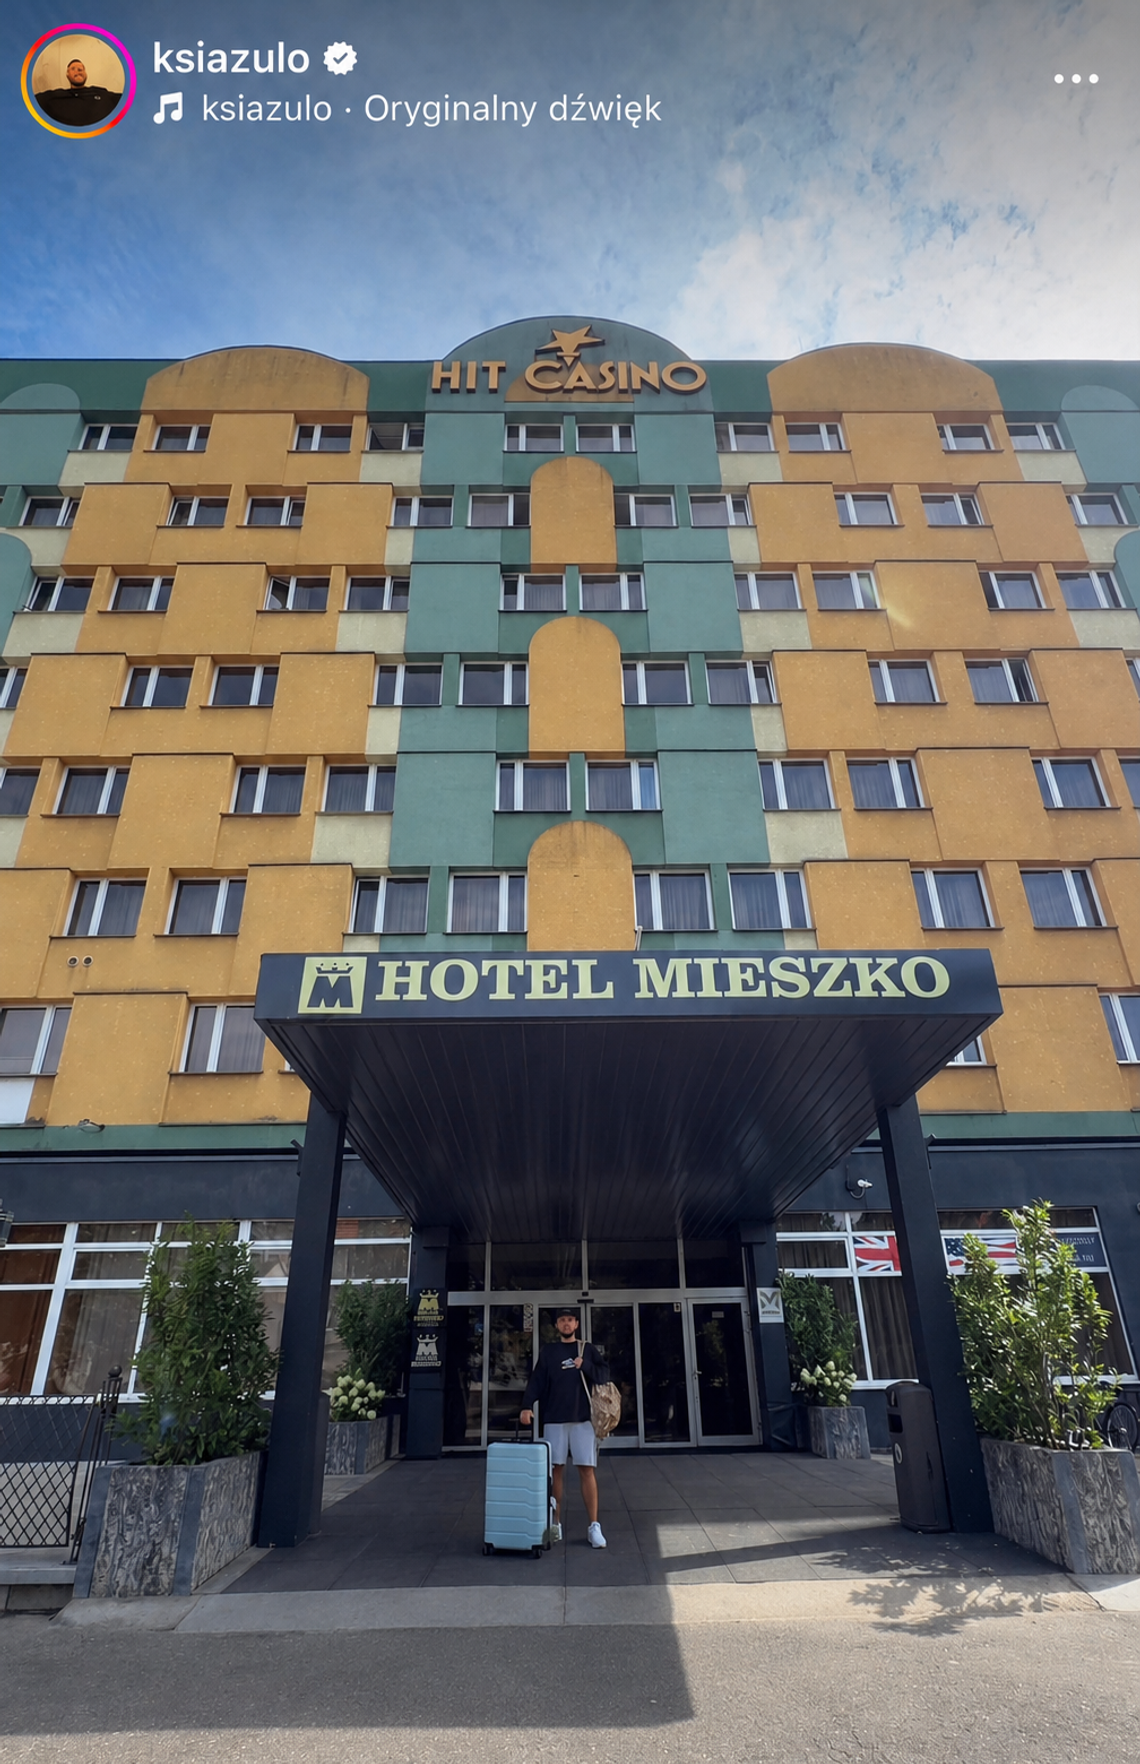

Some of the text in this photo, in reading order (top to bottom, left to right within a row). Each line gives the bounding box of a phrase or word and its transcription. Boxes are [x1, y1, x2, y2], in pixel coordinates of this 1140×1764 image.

[431, 359, 707, 393] HIT CASINO
[375, 958, 614, 1001] HOTEL
[632, 956, 950, 999] MIESZKO
